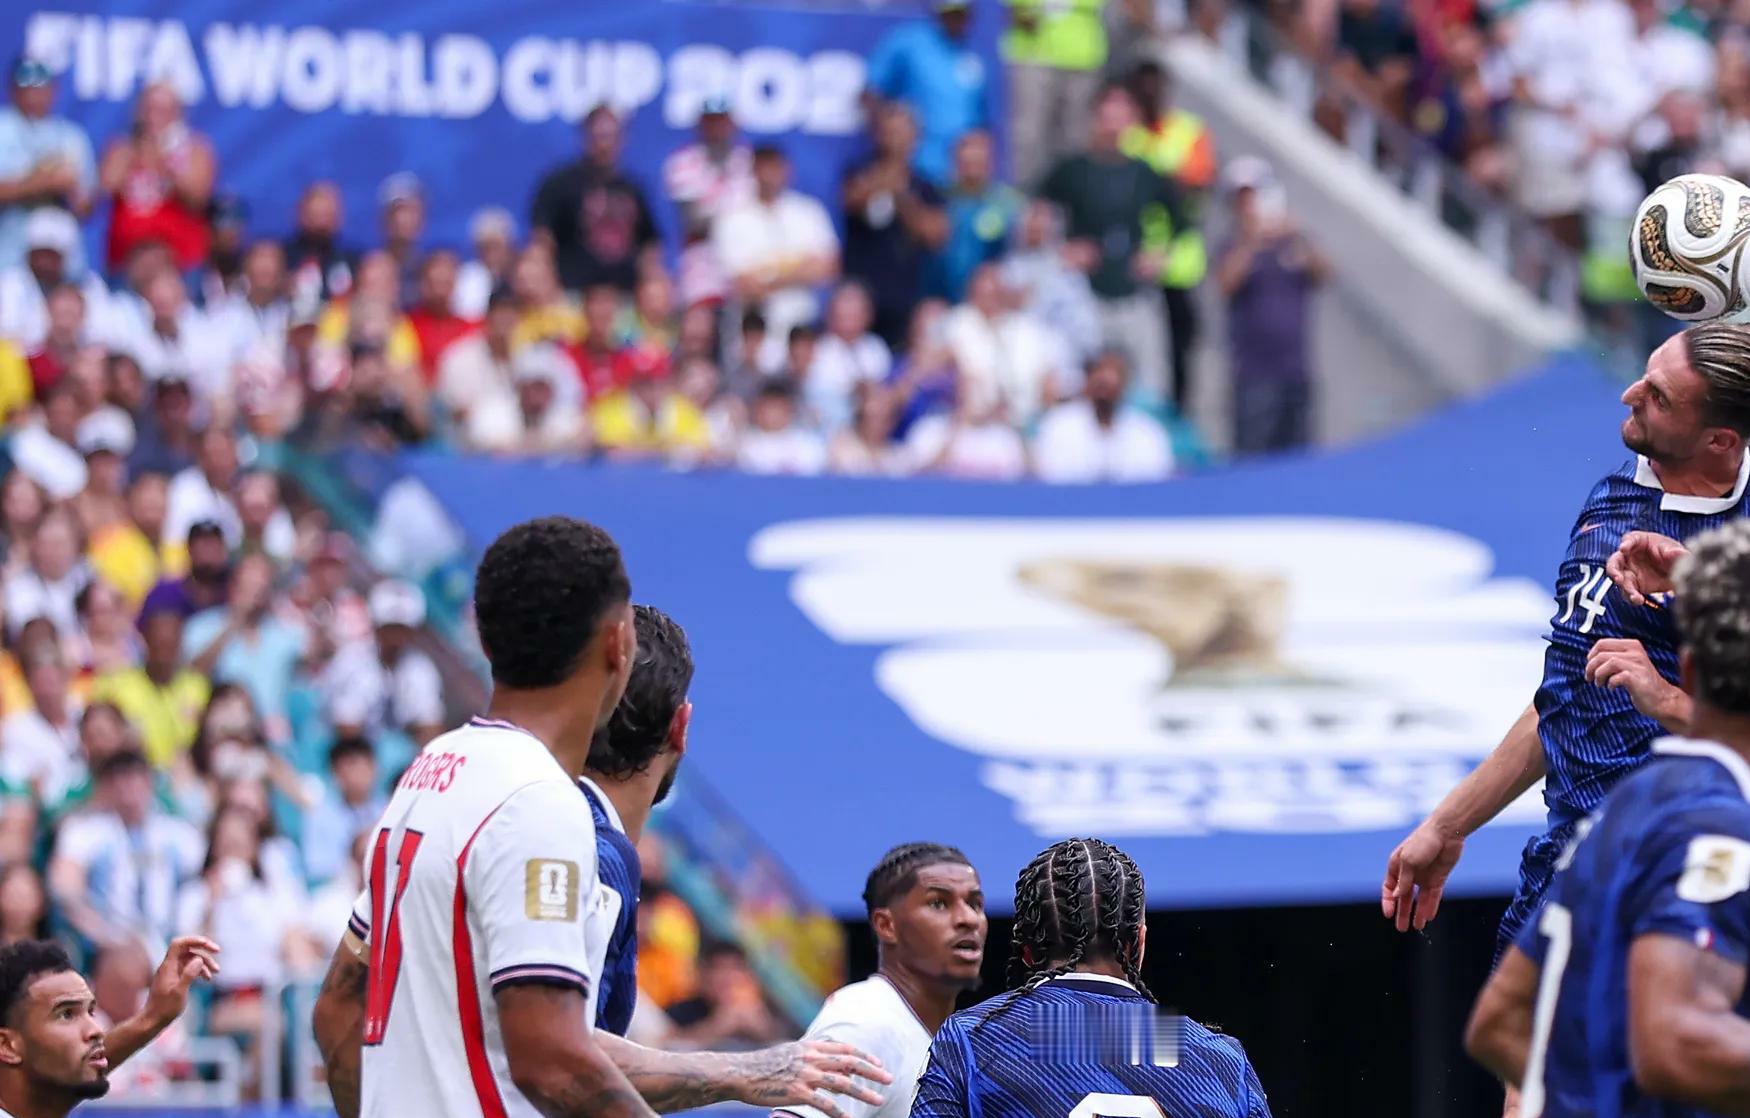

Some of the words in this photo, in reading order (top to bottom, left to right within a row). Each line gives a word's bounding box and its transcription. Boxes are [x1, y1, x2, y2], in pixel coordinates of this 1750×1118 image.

[25, 11, 206, 106] FIFA
[205, 21, 499, 119] WORLD
[502, 35, 663, 123] CUP
[664, 44, 868, 135] 202
[1560, 564, 1613, 633] 14
